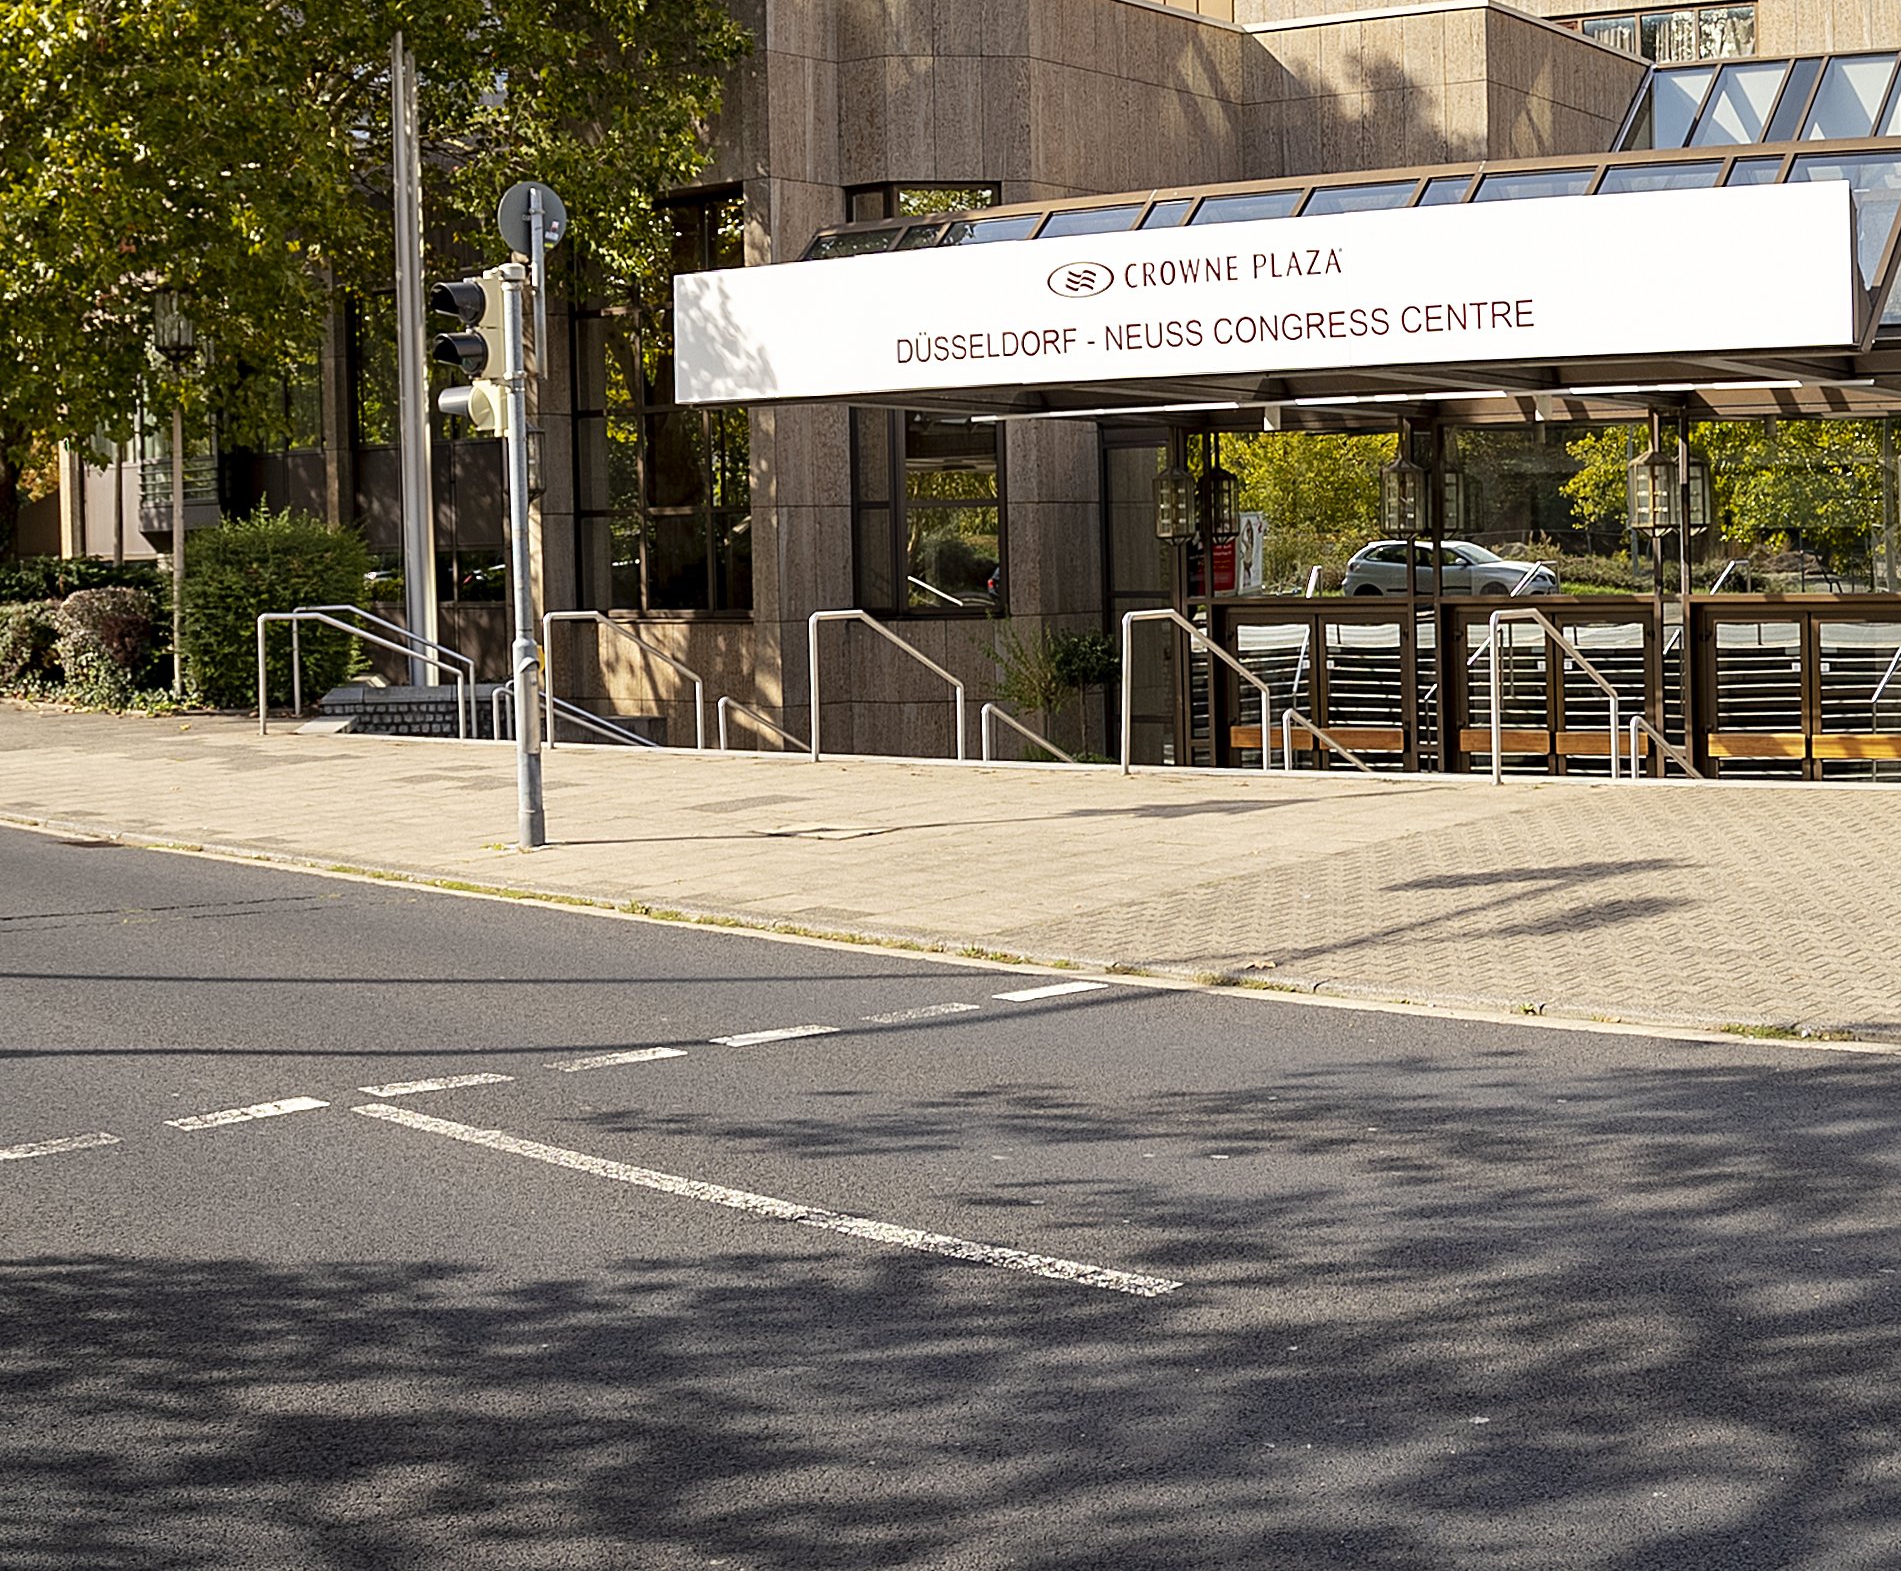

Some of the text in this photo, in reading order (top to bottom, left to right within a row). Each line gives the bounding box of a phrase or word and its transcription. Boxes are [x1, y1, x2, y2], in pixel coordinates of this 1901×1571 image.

[1124, 248, 1342, 289] CROWNE PLAZA
[896, 327, 1077, 364] DÜSSELDORF
[1104, 319, 1204, 352] NEUSS
[1213, 307, 1390, 345] CONGRESS
[1400, 299, 1535, 334] CENTRE
